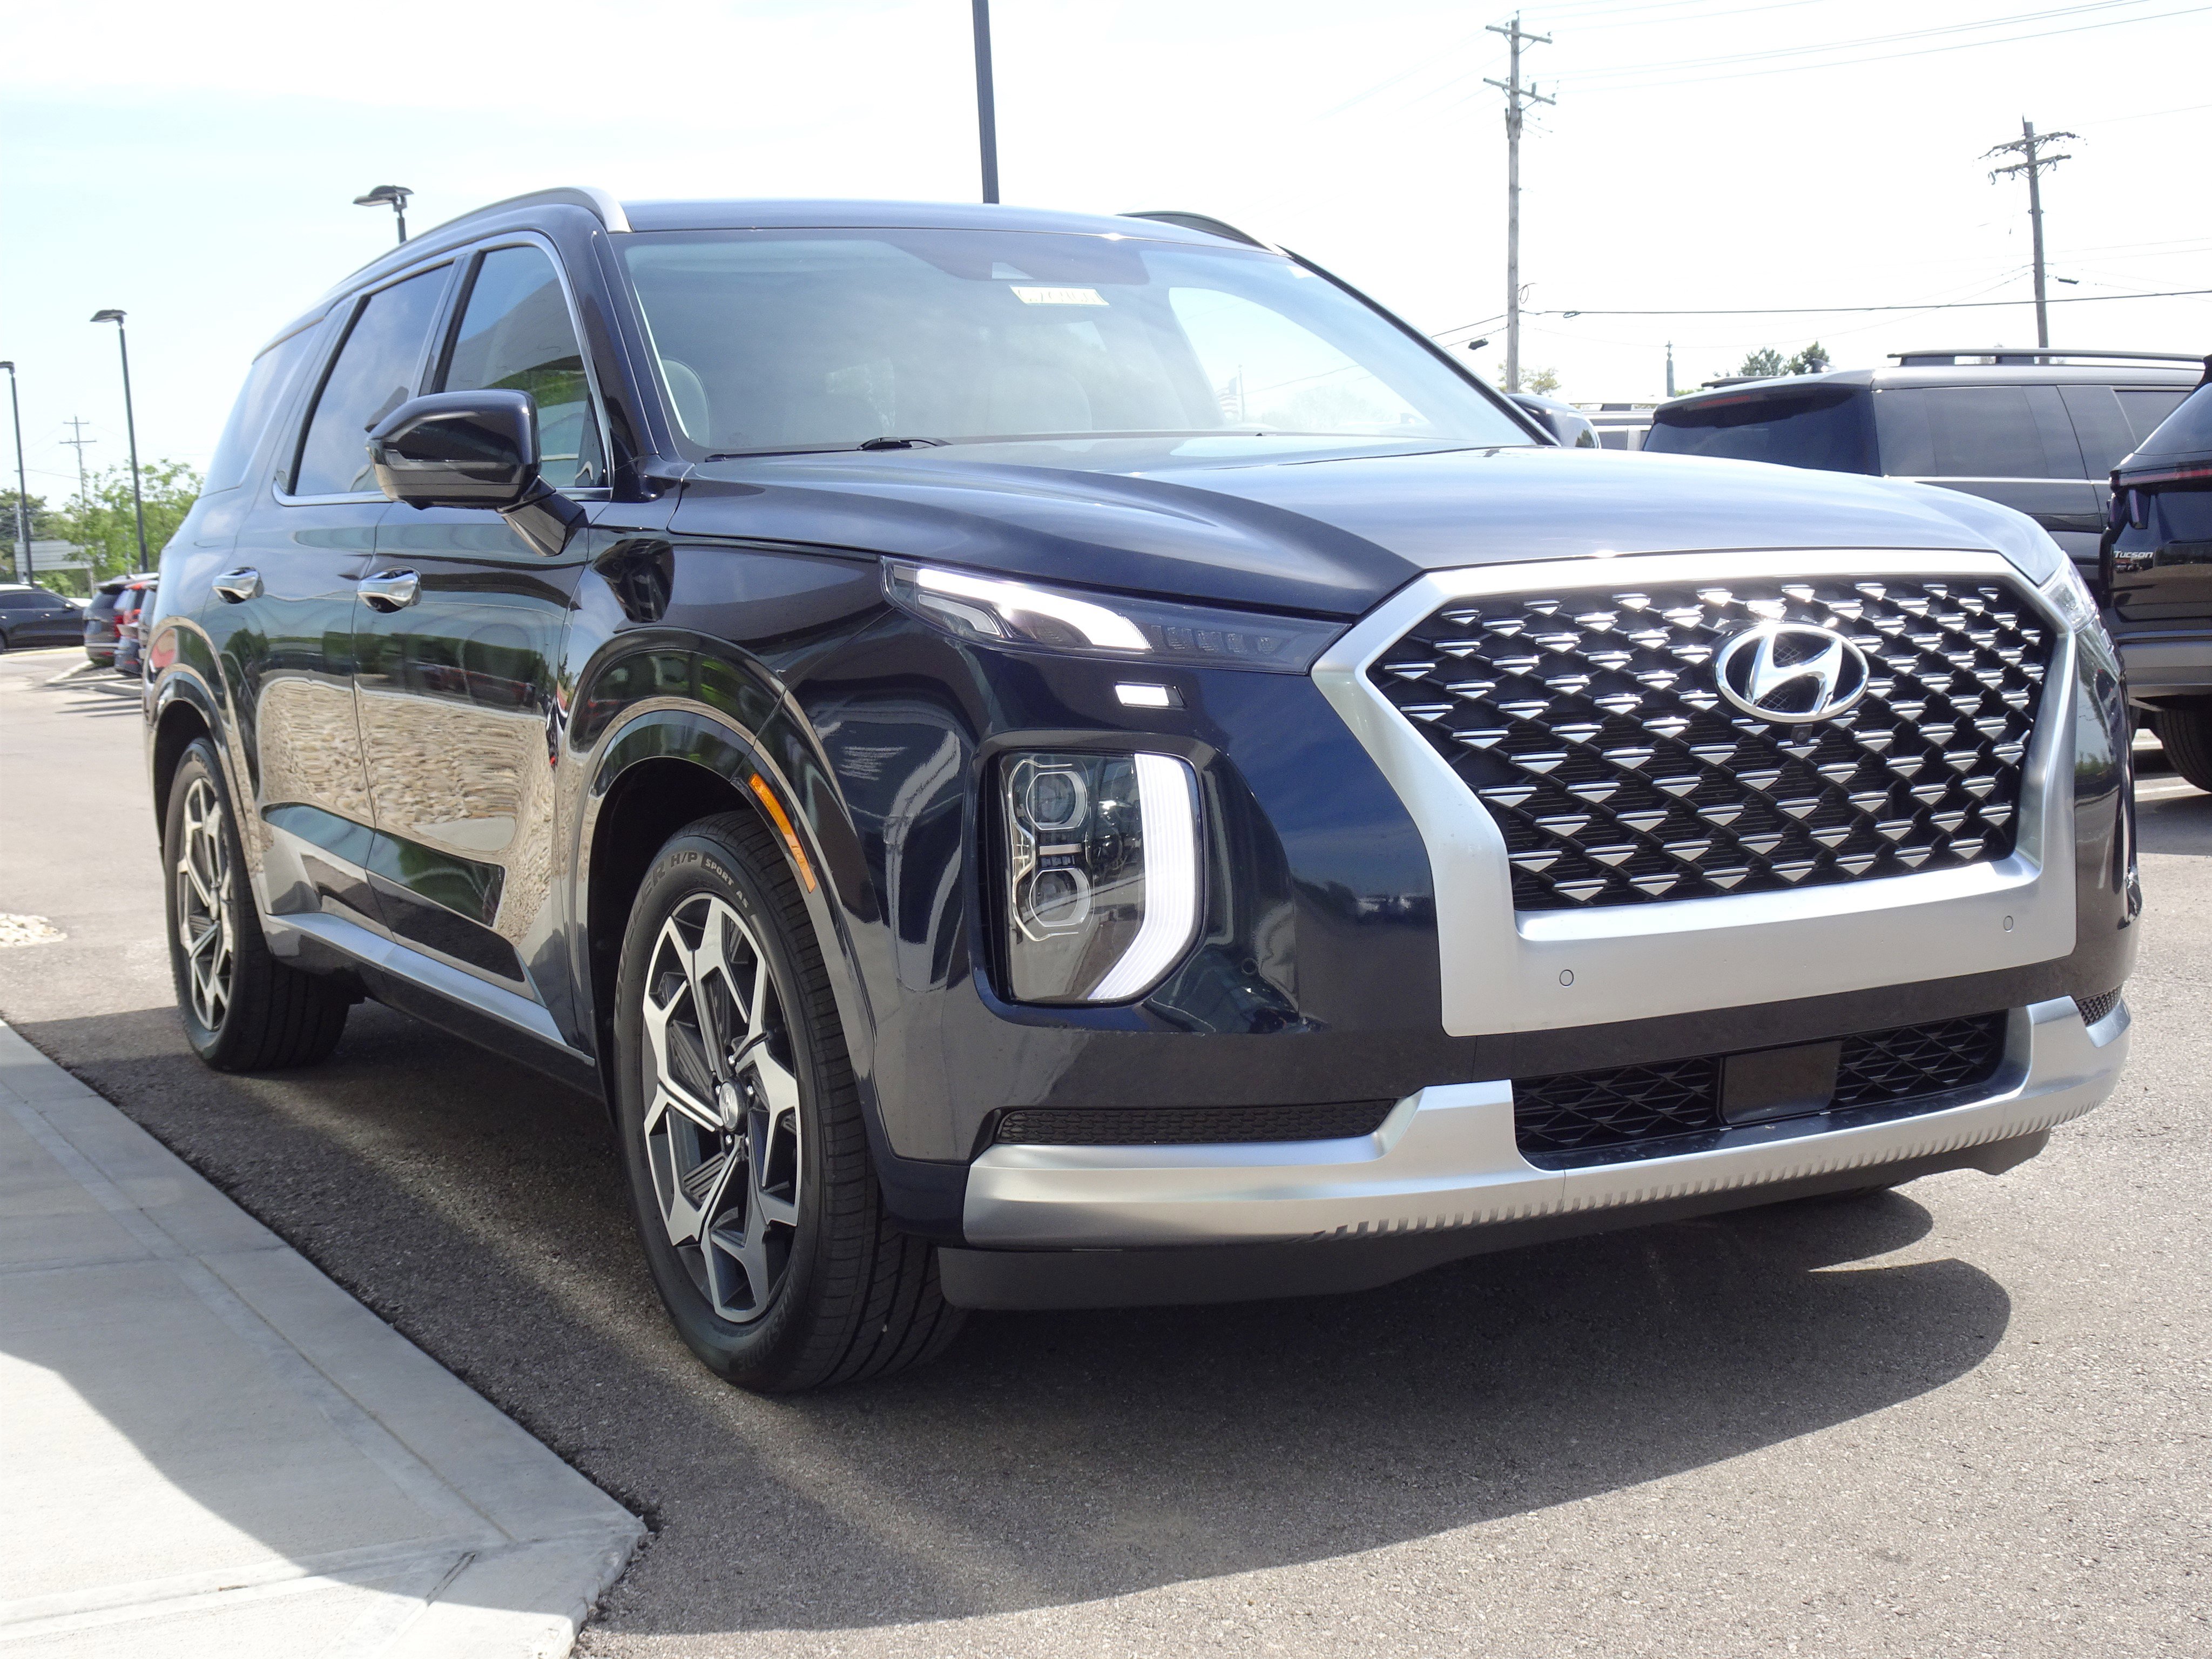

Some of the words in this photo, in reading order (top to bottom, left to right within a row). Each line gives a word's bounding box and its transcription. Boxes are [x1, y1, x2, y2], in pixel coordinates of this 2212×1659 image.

[670, 852, 698, 867] H/P
[705, 858, 734, 886] SPORT
[736, 890, 749, 908] AS
